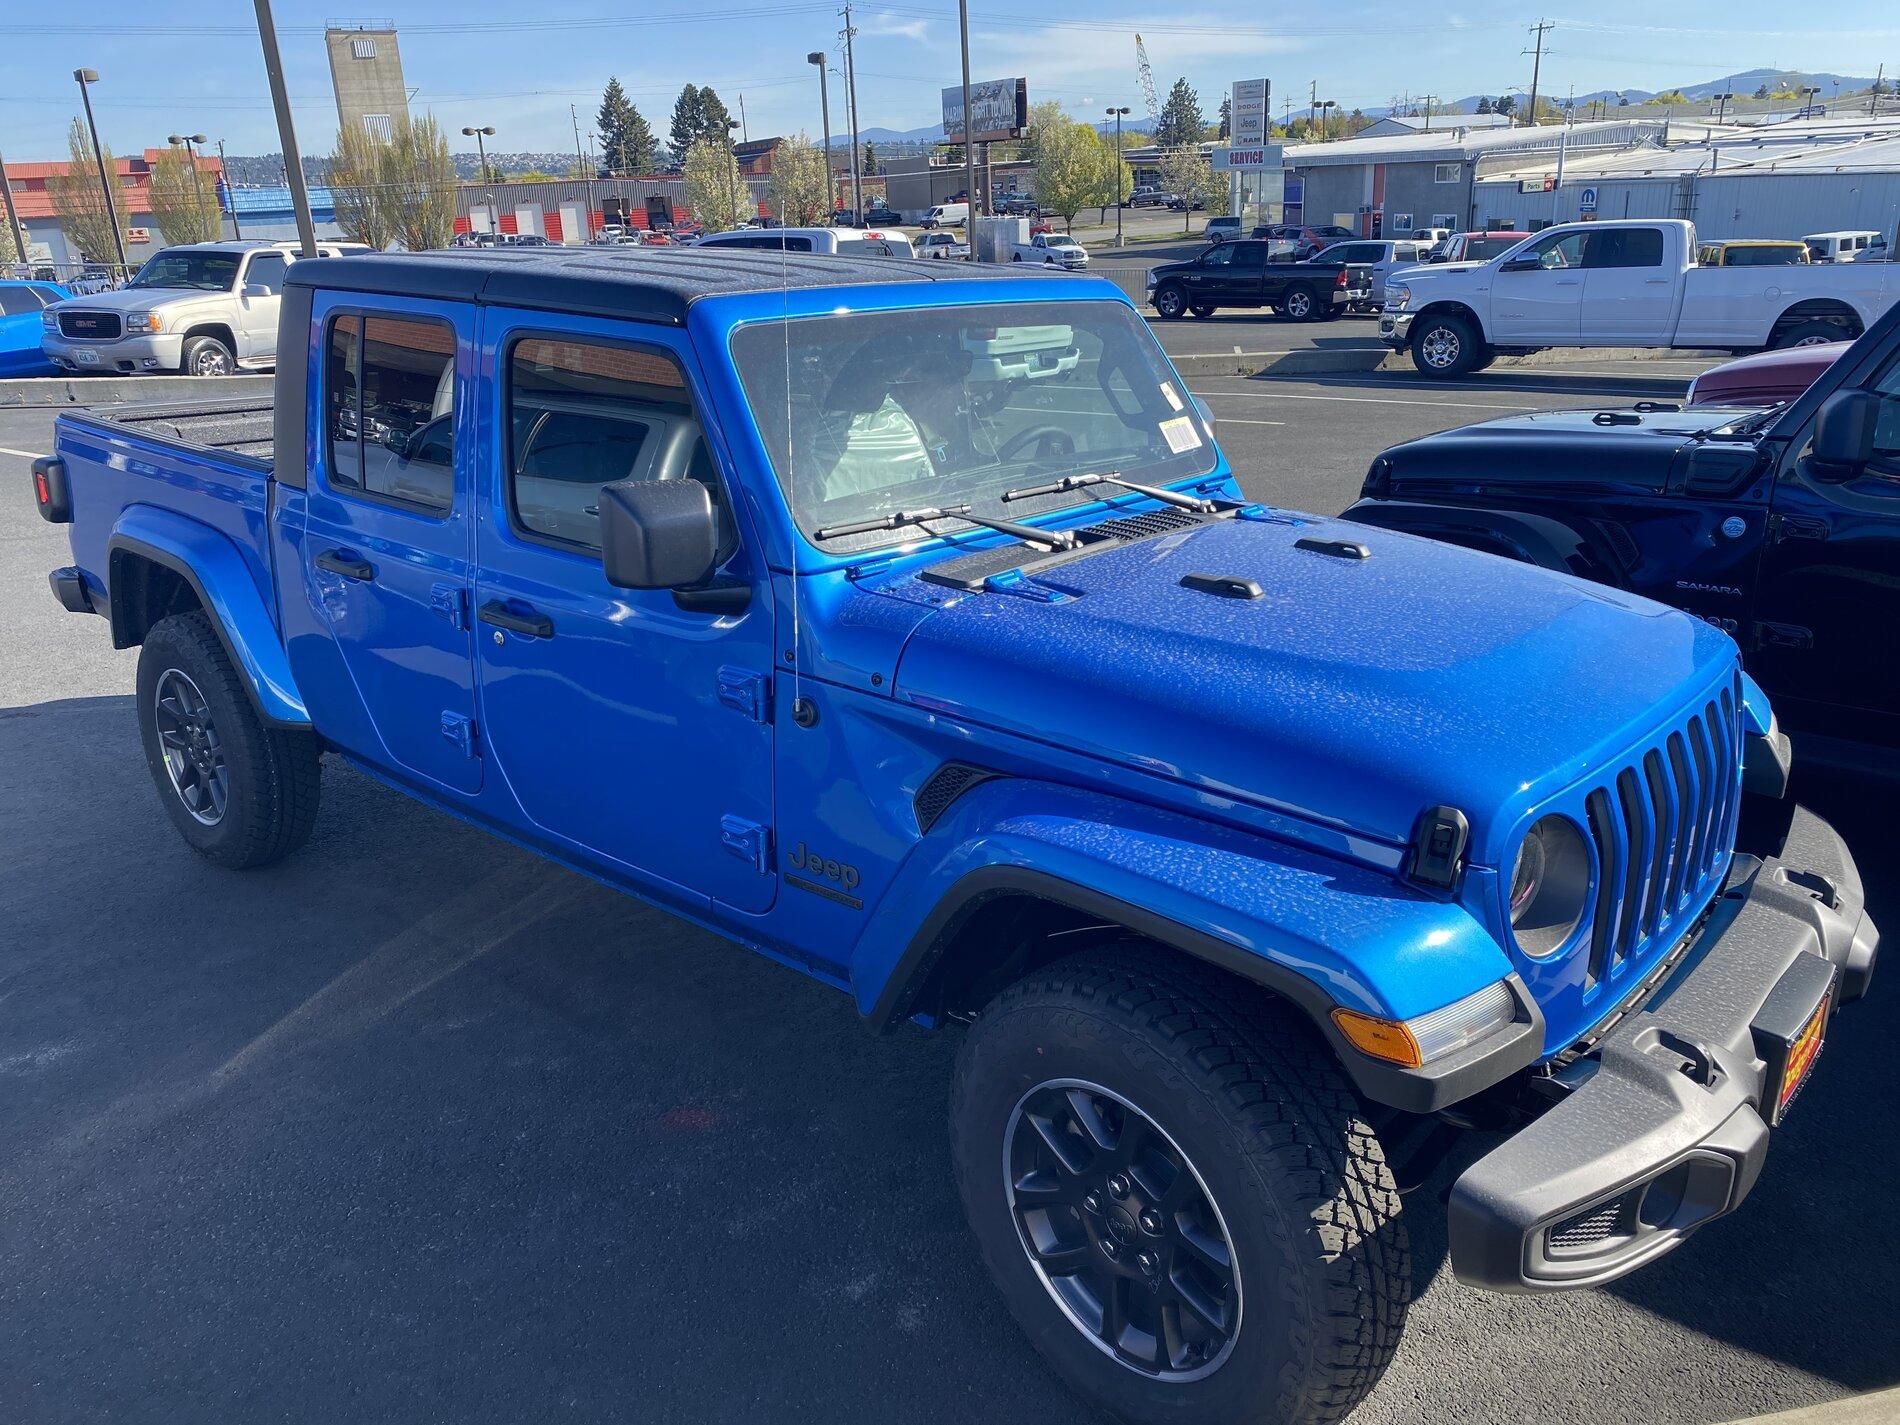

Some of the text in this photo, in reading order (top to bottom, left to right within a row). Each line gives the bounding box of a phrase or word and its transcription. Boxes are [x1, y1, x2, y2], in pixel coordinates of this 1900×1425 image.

[1240, 117, 1258, 129] Jeep
[1229, 150, 1264, 165] SERVICE
[75, 320, 97, 328] GMC
[1675, 580, 1742, 597] SAHARA
[787, 841, 860, 891] Jeep
